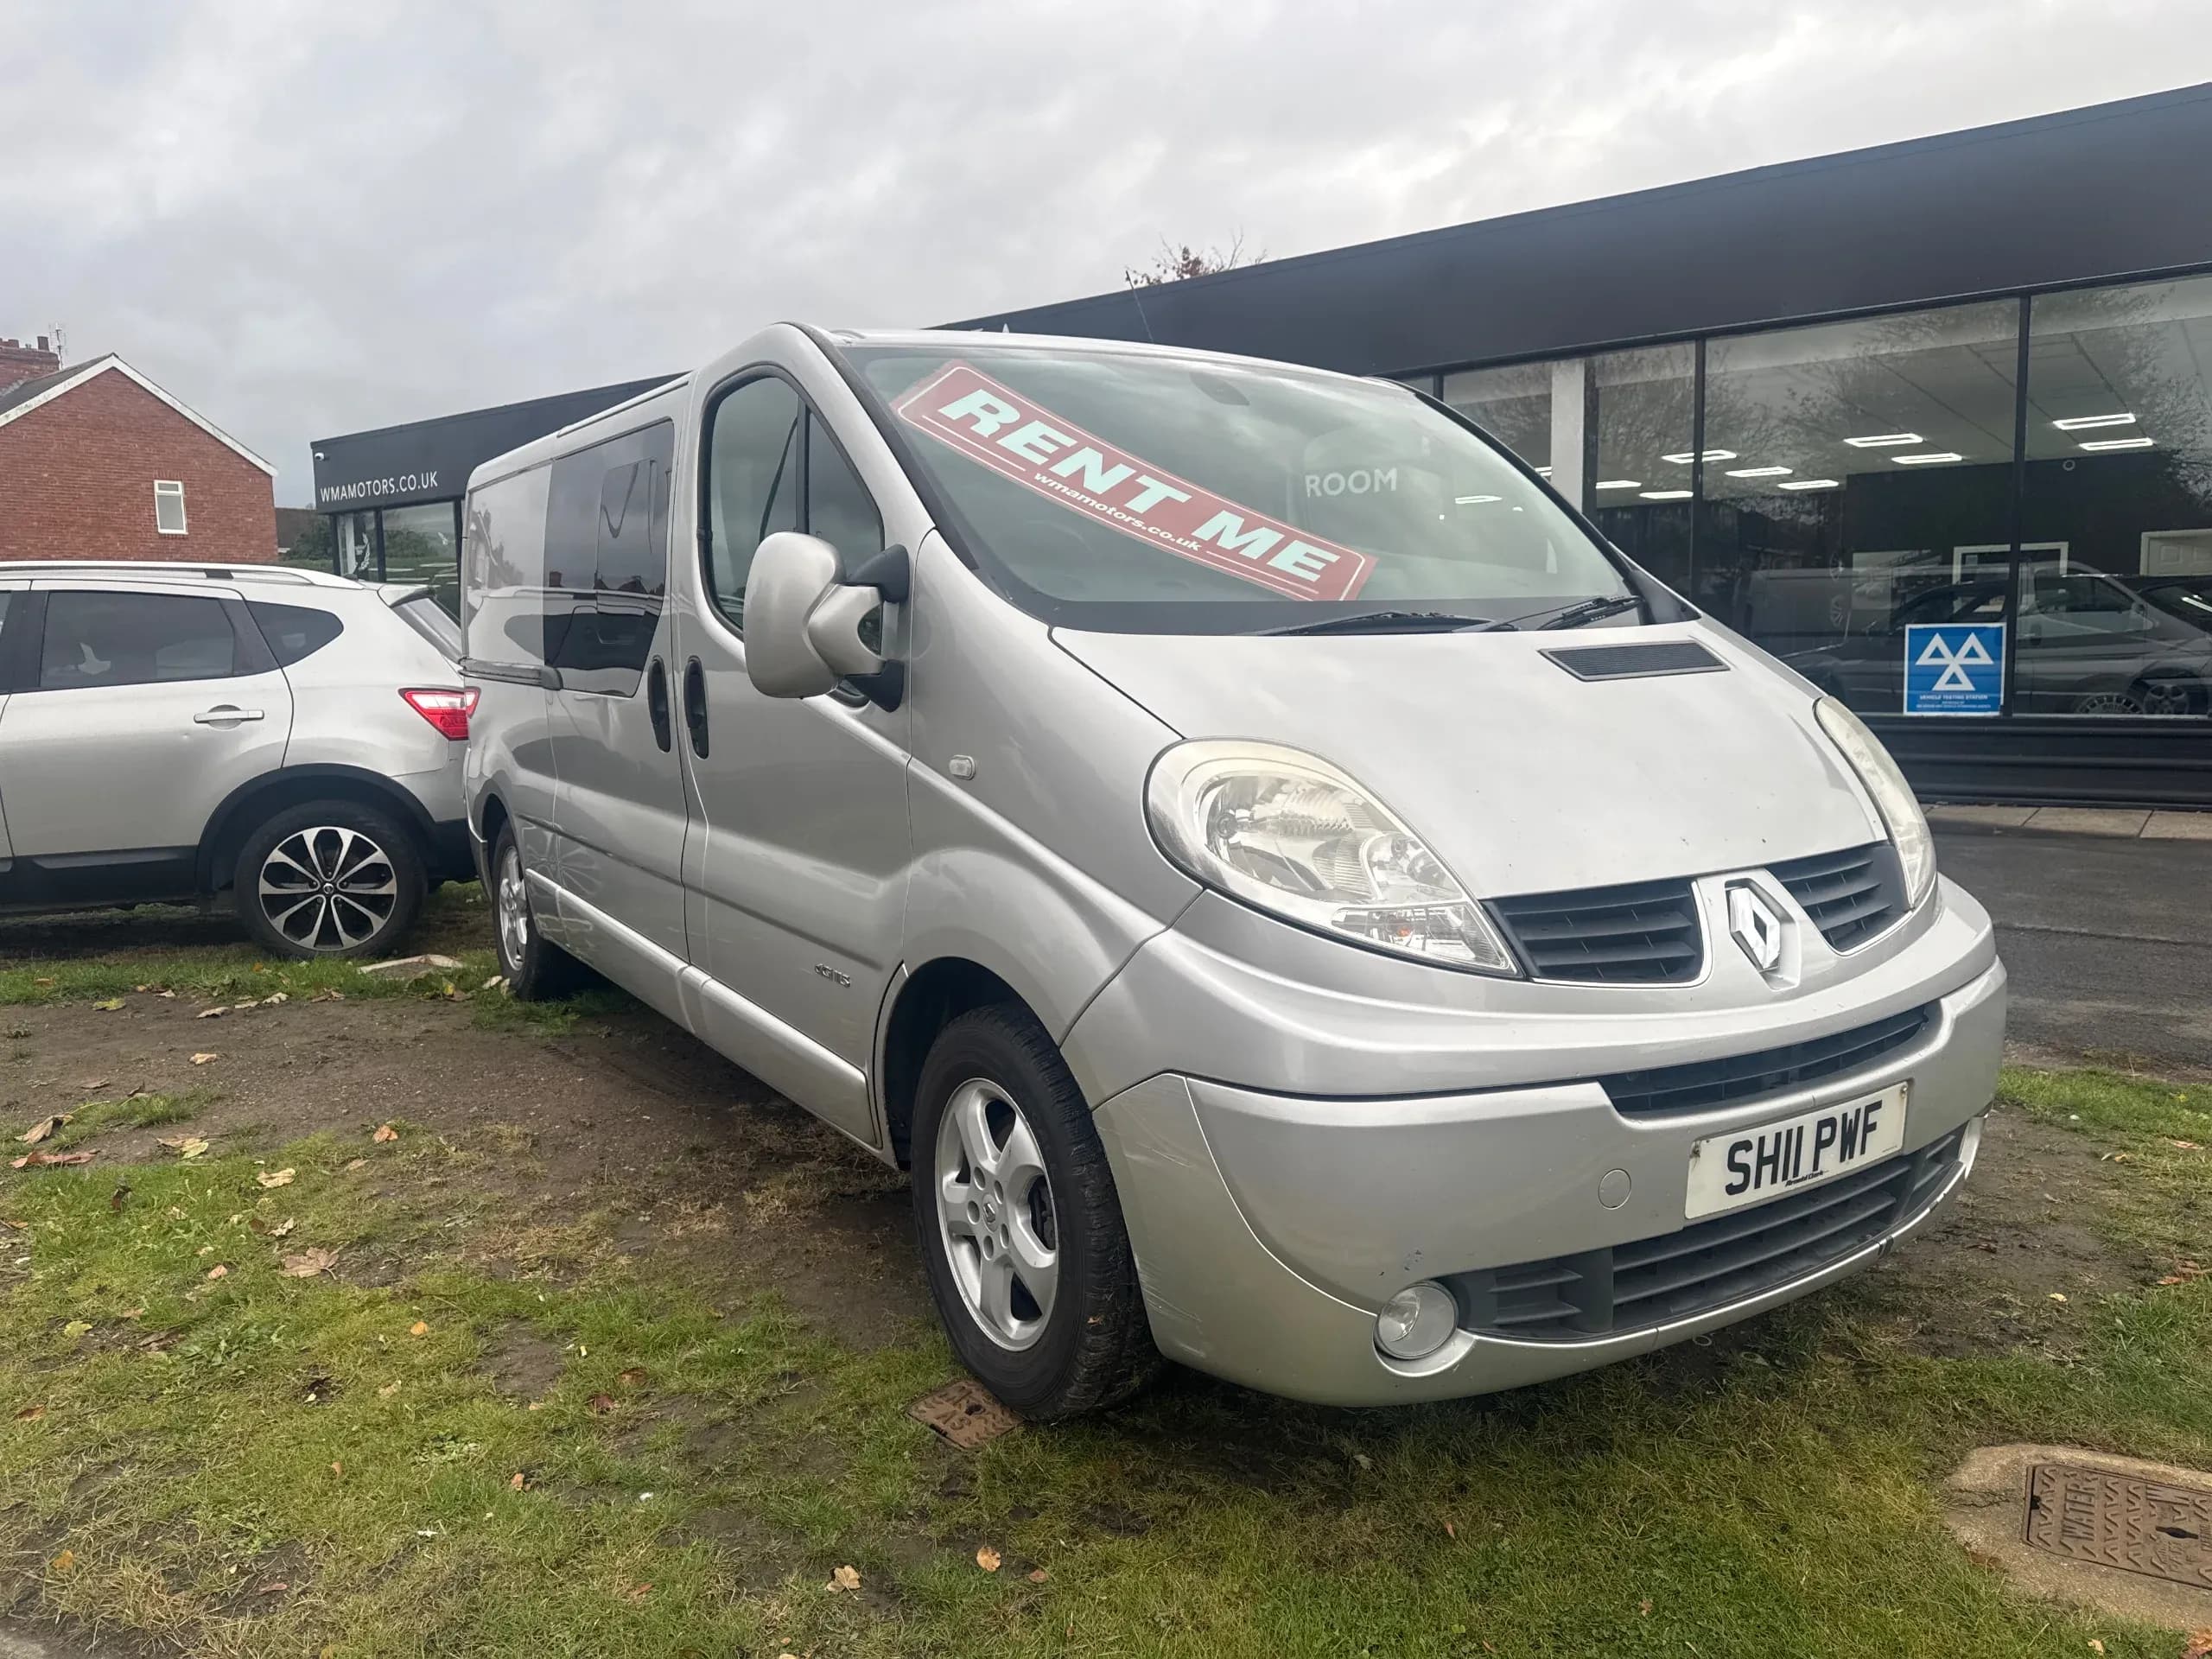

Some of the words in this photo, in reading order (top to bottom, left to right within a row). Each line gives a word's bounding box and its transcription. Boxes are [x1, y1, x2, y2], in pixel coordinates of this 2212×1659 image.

[320, 470, 439, 503] WMAMOTORS.CO.UK
[938, 388, 1193, 514] RENT
[1190, 509, 1342, 583] ME
[1033, 473, 1203, 552] wmamotors.co.uk
[1304, 467, 1398, 498] ROOM
[1725, 1125, 1804, 1196] SH11
[1812, 1099, 1883, 1172] PWF
